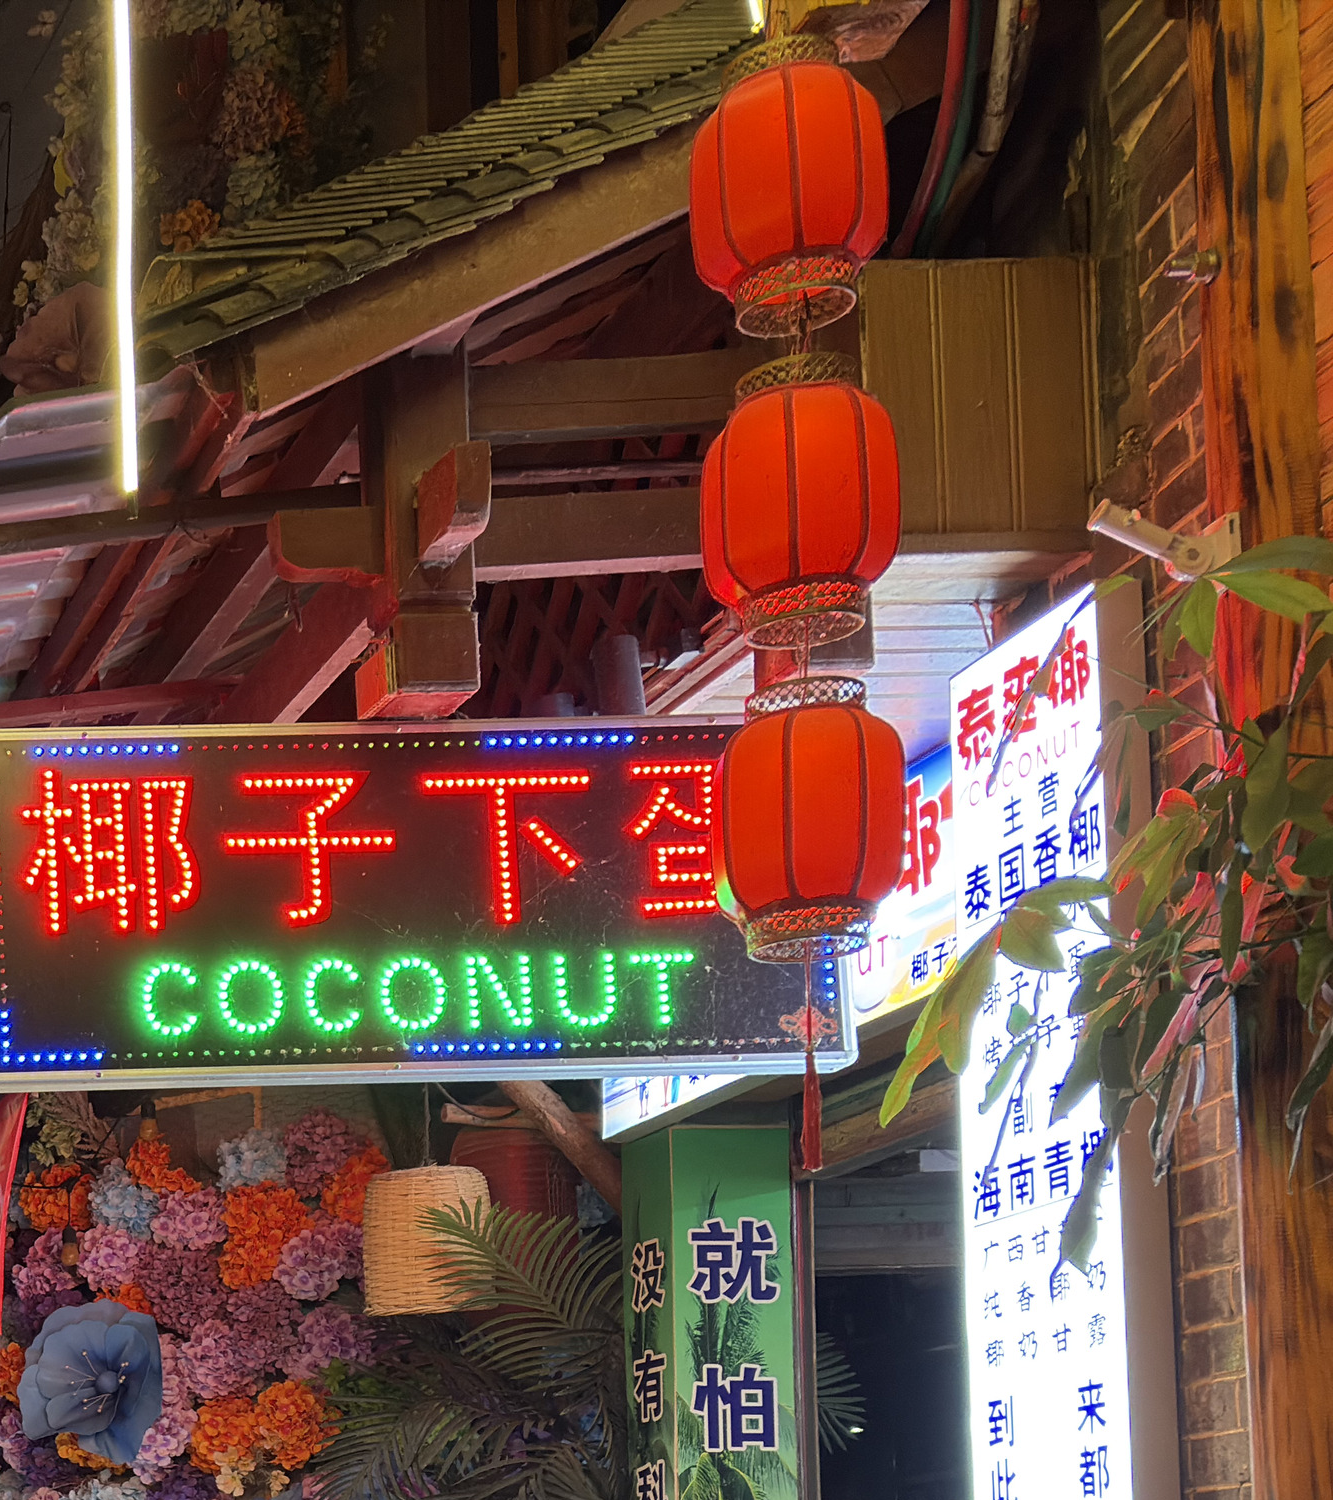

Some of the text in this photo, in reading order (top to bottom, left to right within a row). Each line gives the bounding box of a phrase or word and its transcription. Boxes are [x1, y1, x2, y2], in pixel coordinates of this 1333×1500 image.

[965, 803, 1101, 921] 泰国香椰
[142, 952, 695, 1035] COCONUT
